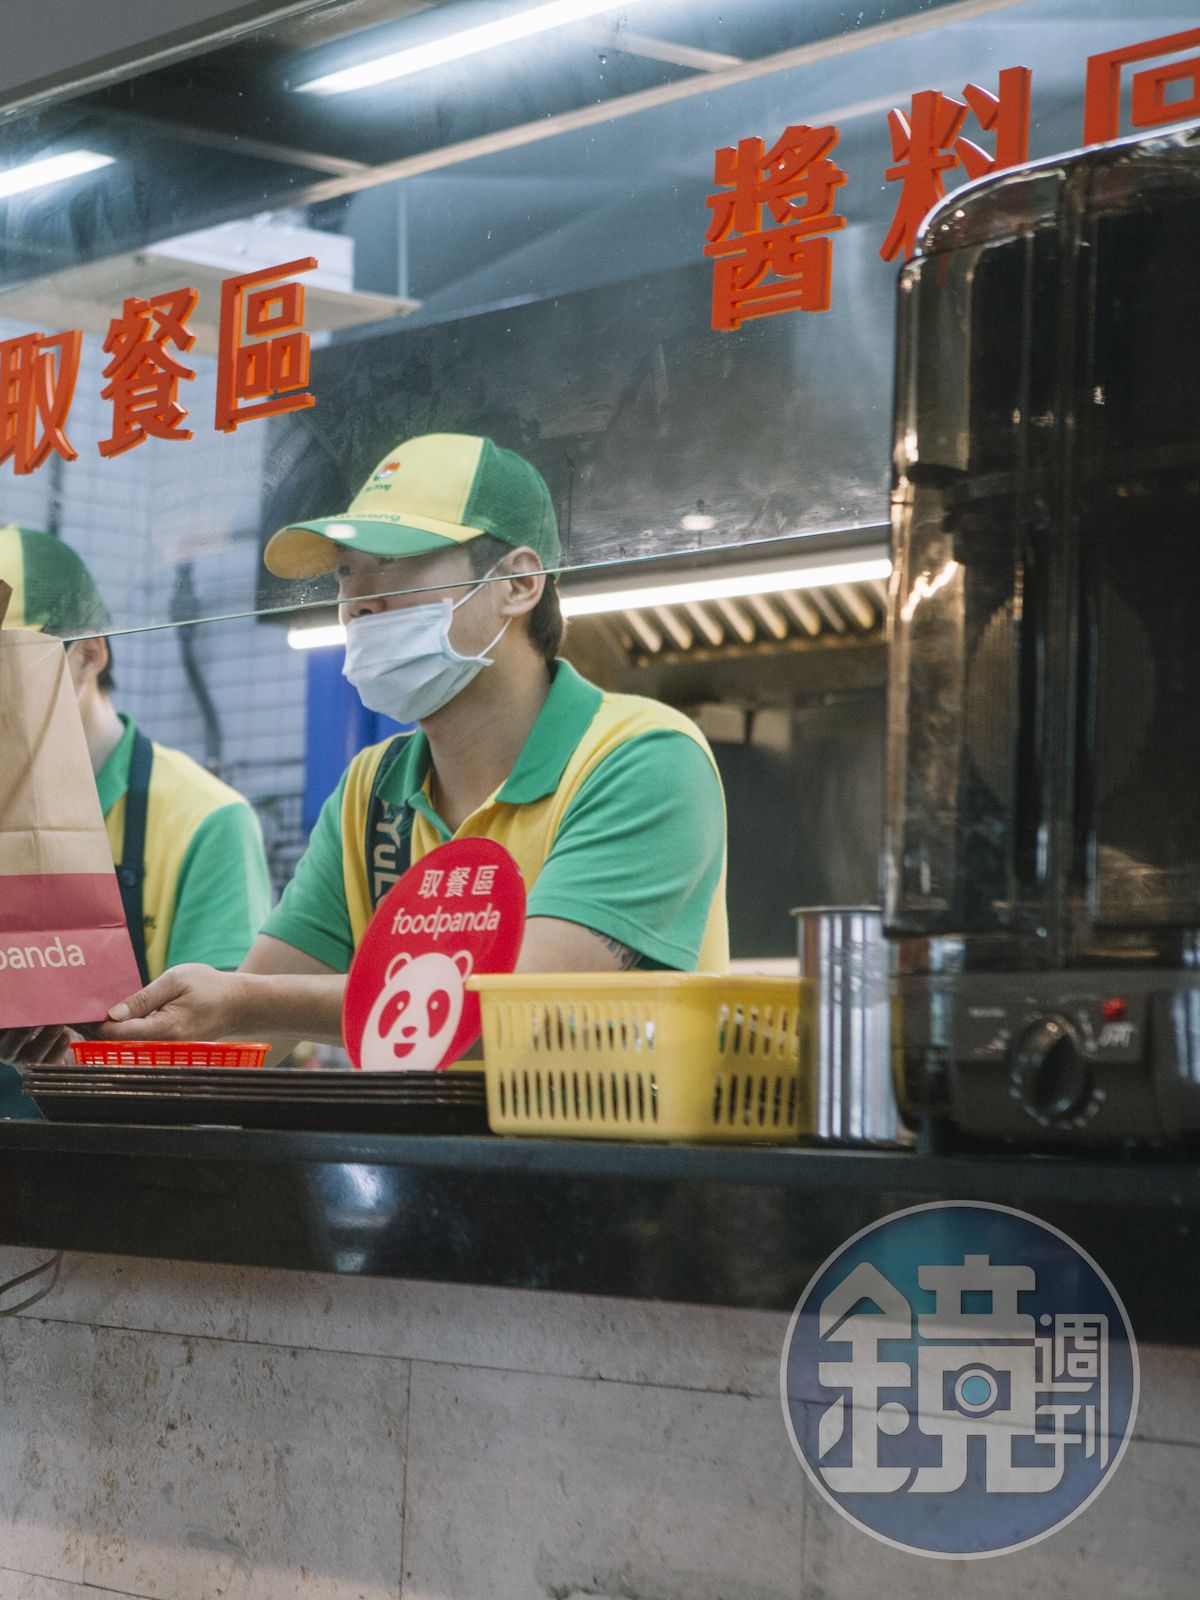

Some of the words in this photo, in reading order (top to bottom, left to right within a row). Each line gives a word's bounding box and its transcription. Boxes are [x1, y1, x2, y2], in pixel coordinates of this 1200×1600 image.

[417, 865, 499, 899] 取餐區
[391, 903, 501, 941] foodpanda
